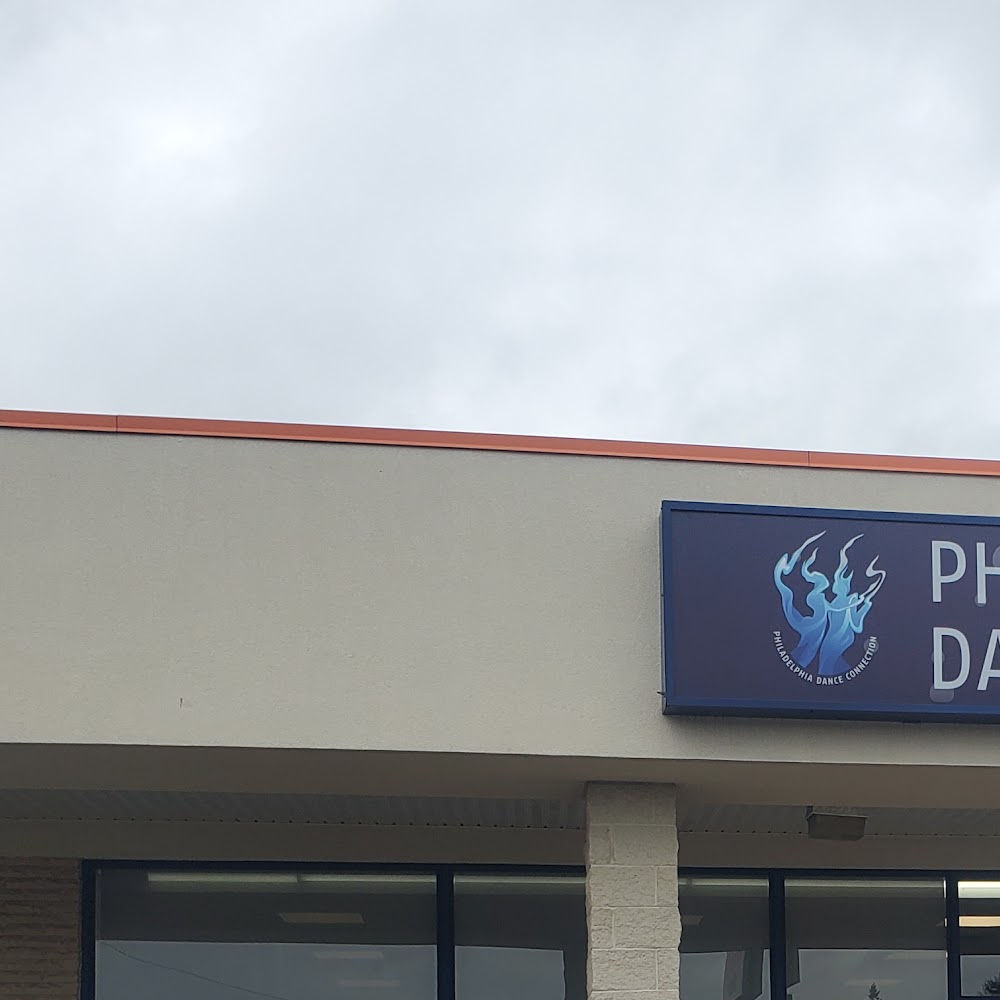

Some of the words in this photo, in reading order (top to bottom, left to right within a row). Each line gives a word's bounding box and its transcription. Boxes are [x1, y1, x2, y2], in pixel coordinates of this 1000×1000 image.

[773, 630, 813, 683] PHILADELPHIA
[816, 675, 844, 685] DANCE
[845, 636, 877, 680] CONNECTION
